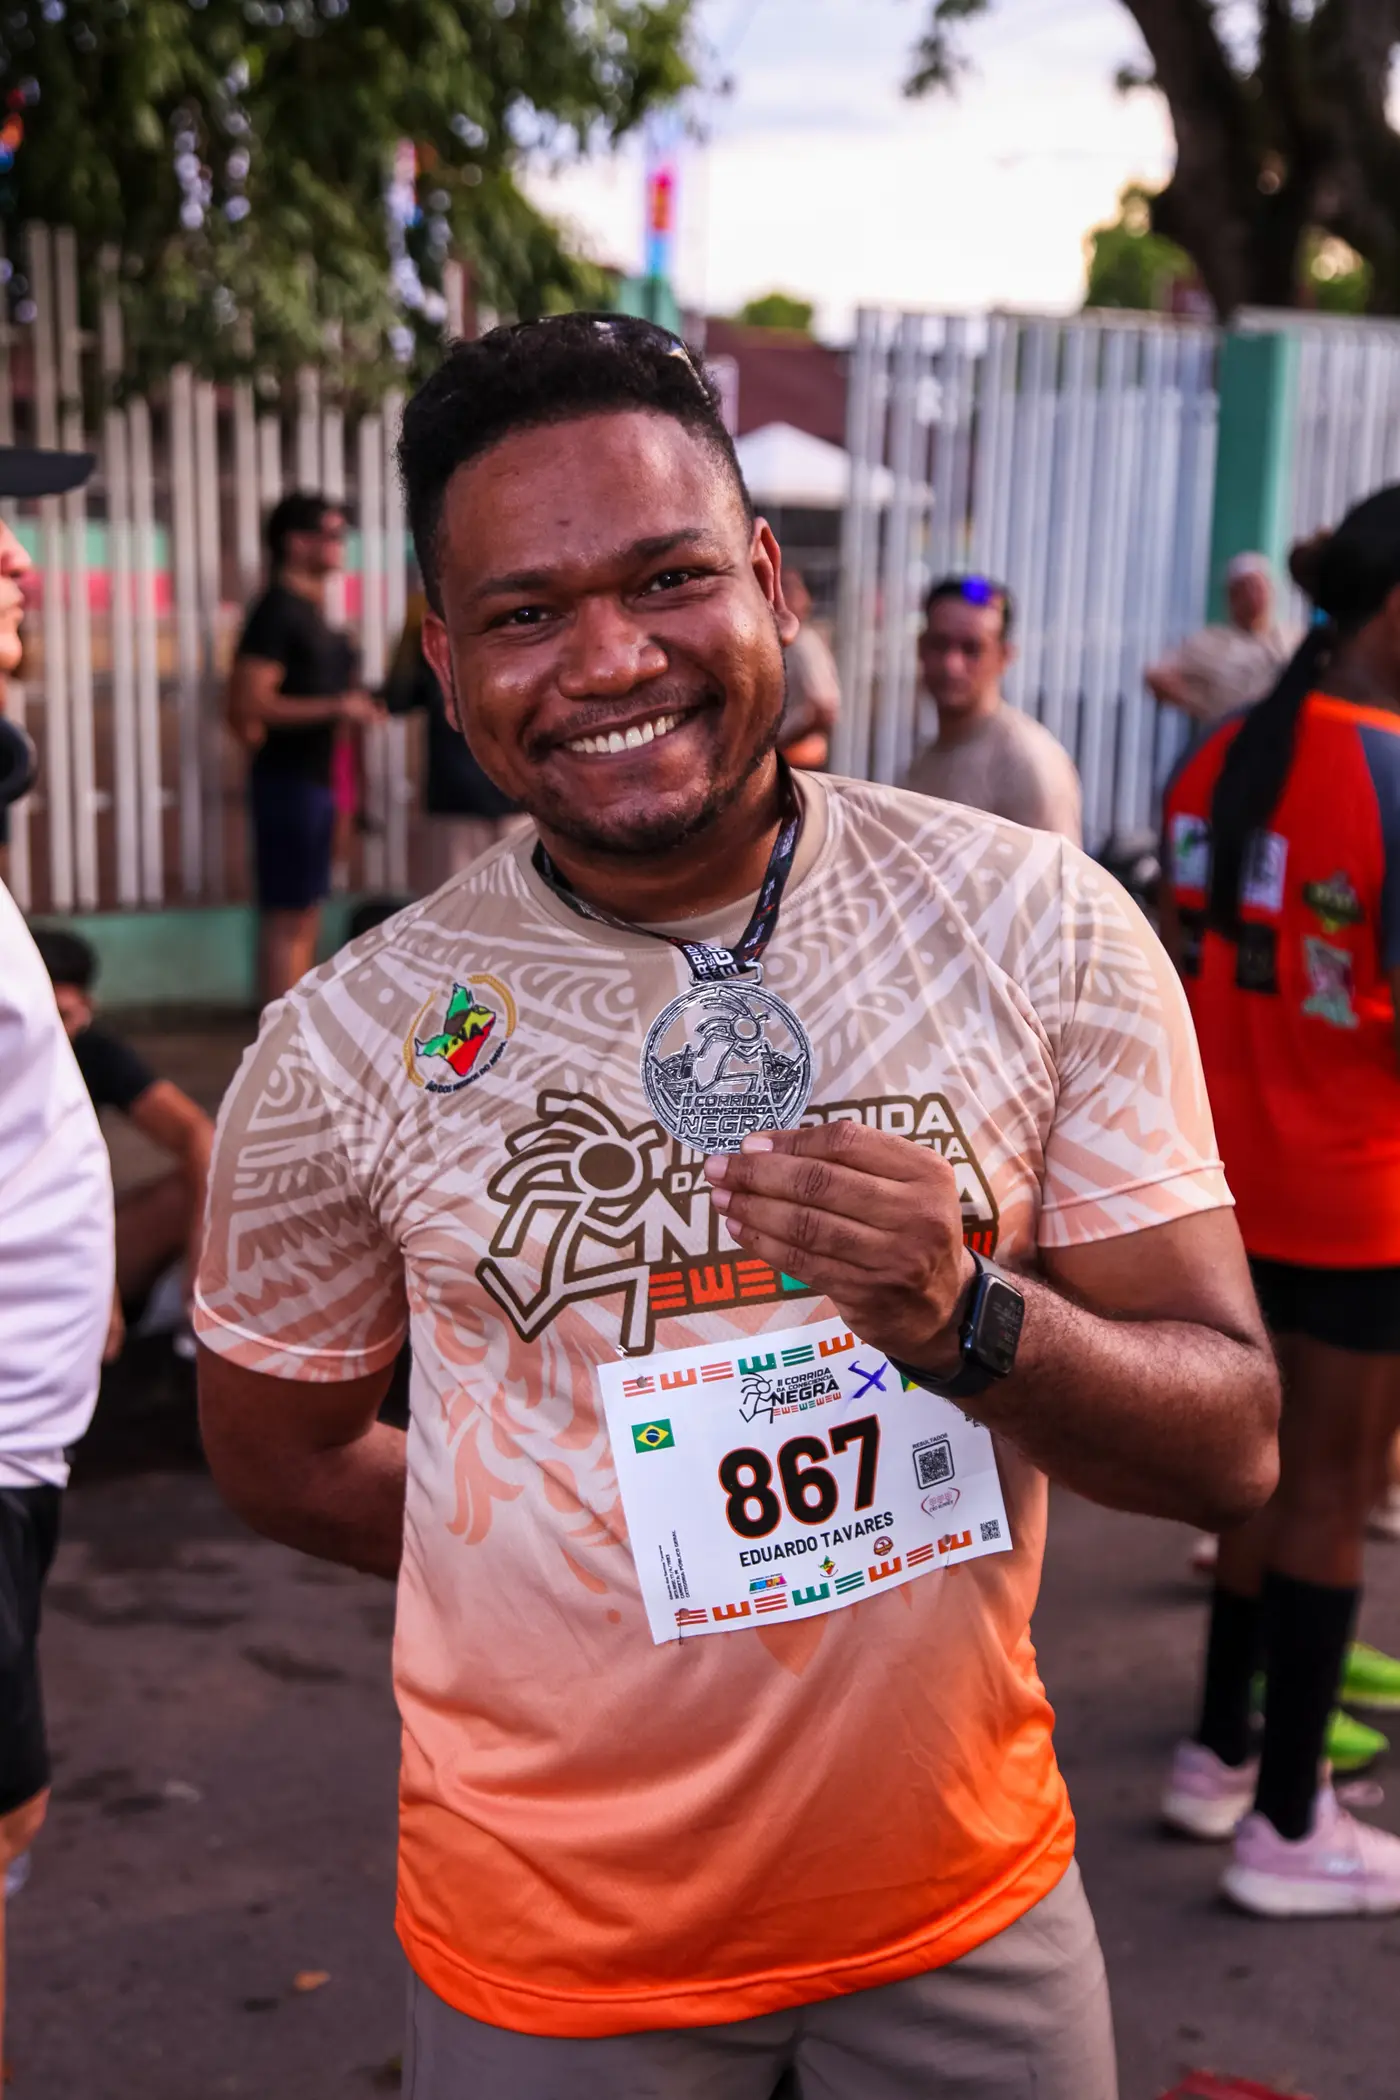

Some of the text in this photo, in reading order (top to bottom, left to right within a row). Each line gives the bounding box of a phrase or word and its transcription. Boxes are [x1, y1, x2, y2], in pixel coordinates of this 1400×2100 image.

[694, 1094, 772, 1107] CORRIDA
[681, 1107, 696, 1116] DA
[679, 1115, 780, 1134] NEGRA
[785, 1367, 831, 1386] CORRIDA
[771, 1379, 840, 1407] NEGRA
[912, 1432, 949, 1449] RESULTADOS
[718, 1413, 882, 1540] 867
[739, 1511, 894, 1568] EDUARDO TAVARES
